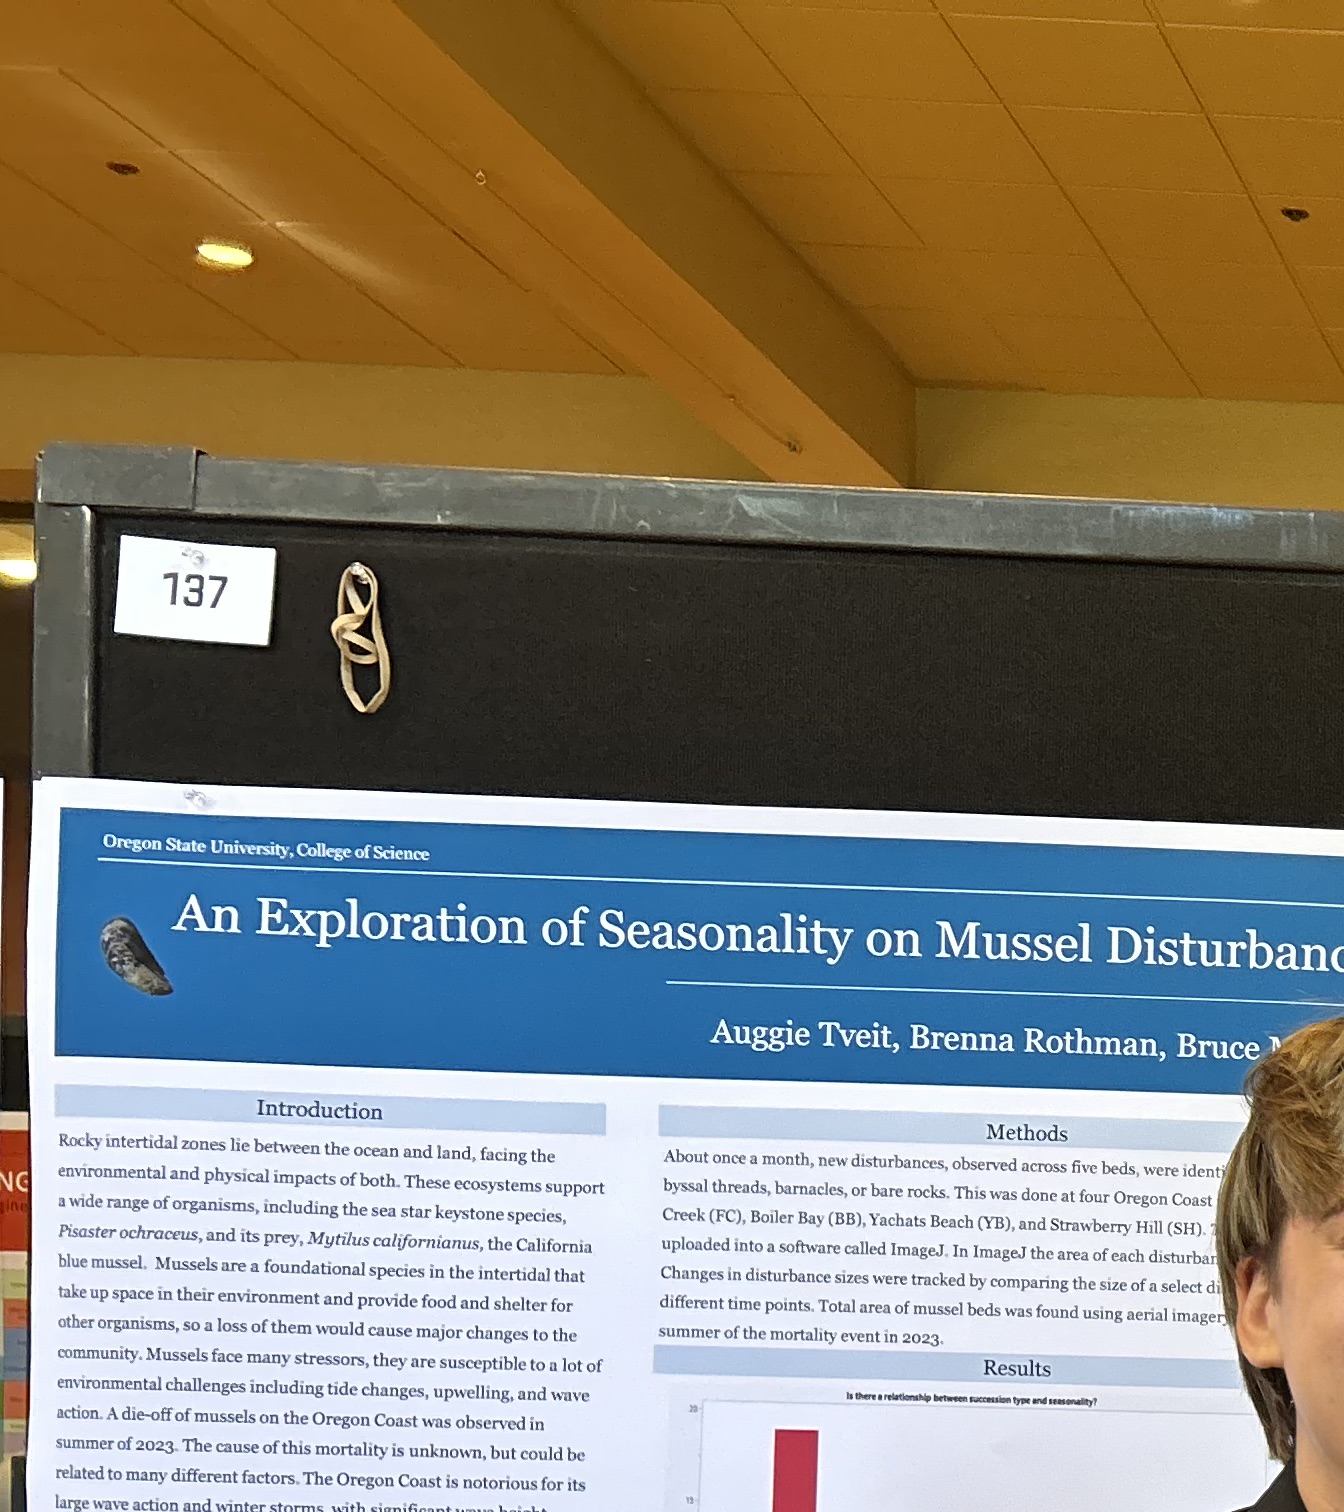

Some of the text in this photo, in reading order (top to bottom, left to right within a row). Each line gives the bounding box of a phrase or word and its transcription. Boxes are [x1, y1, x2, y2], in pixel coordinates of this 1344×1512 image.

[163, 572, 228, 608] 137
[103, 833, 430, 861] Oregon State University, College of Science
[170, 893, 242, 933] An
[255, 897, 528, 948] Exploration
[542, 905, 590, 946] of
[599, 909, 854, 965] Seasonality
[866, 928, 922, 957] on
[935, 920, 1092, 962] Mussel
[709, 1018, 1260, 1062] Auggie Tveit, Brenna Rothman, Bruce
[257, 1099, 383, 1120] Introduction
[986, 1123, 1068, 1142] Methods
[58, 1131, 555, 1166] Rocky intertidal zones lie between the ocean and land, facing the
[662, 1207, 1206, 1237] Creek (FC), Boiler Bay (BB), Yachats Beach (YB), and Strawberry Hill (SH).
[983, 1359, 1051, 1377] Results
